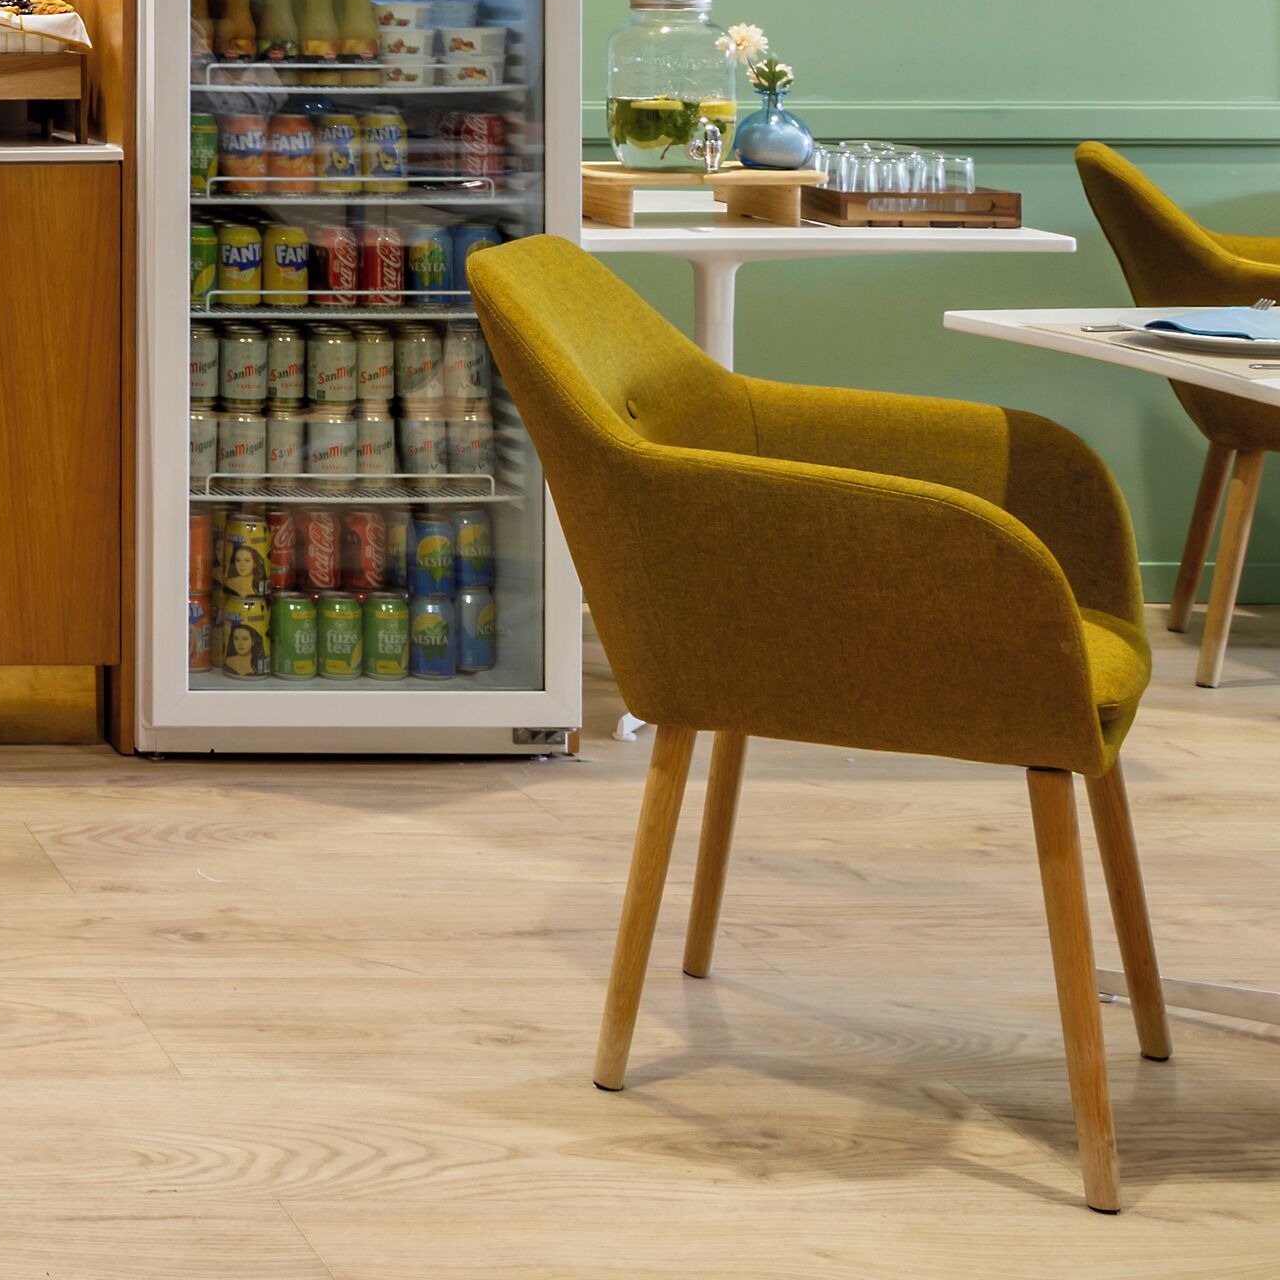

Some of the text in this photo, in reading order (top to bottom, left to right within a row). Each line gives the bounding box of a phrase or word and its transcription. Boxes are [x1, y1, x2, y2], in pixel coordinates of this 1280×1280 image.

[221, 243, 263, 265] FANT
[274, 243, 309, 265] FAN
[326, 629, 357, 644] fuze
[326, 642, 351, 654] tea
[378, 642, 401, 654] tea
